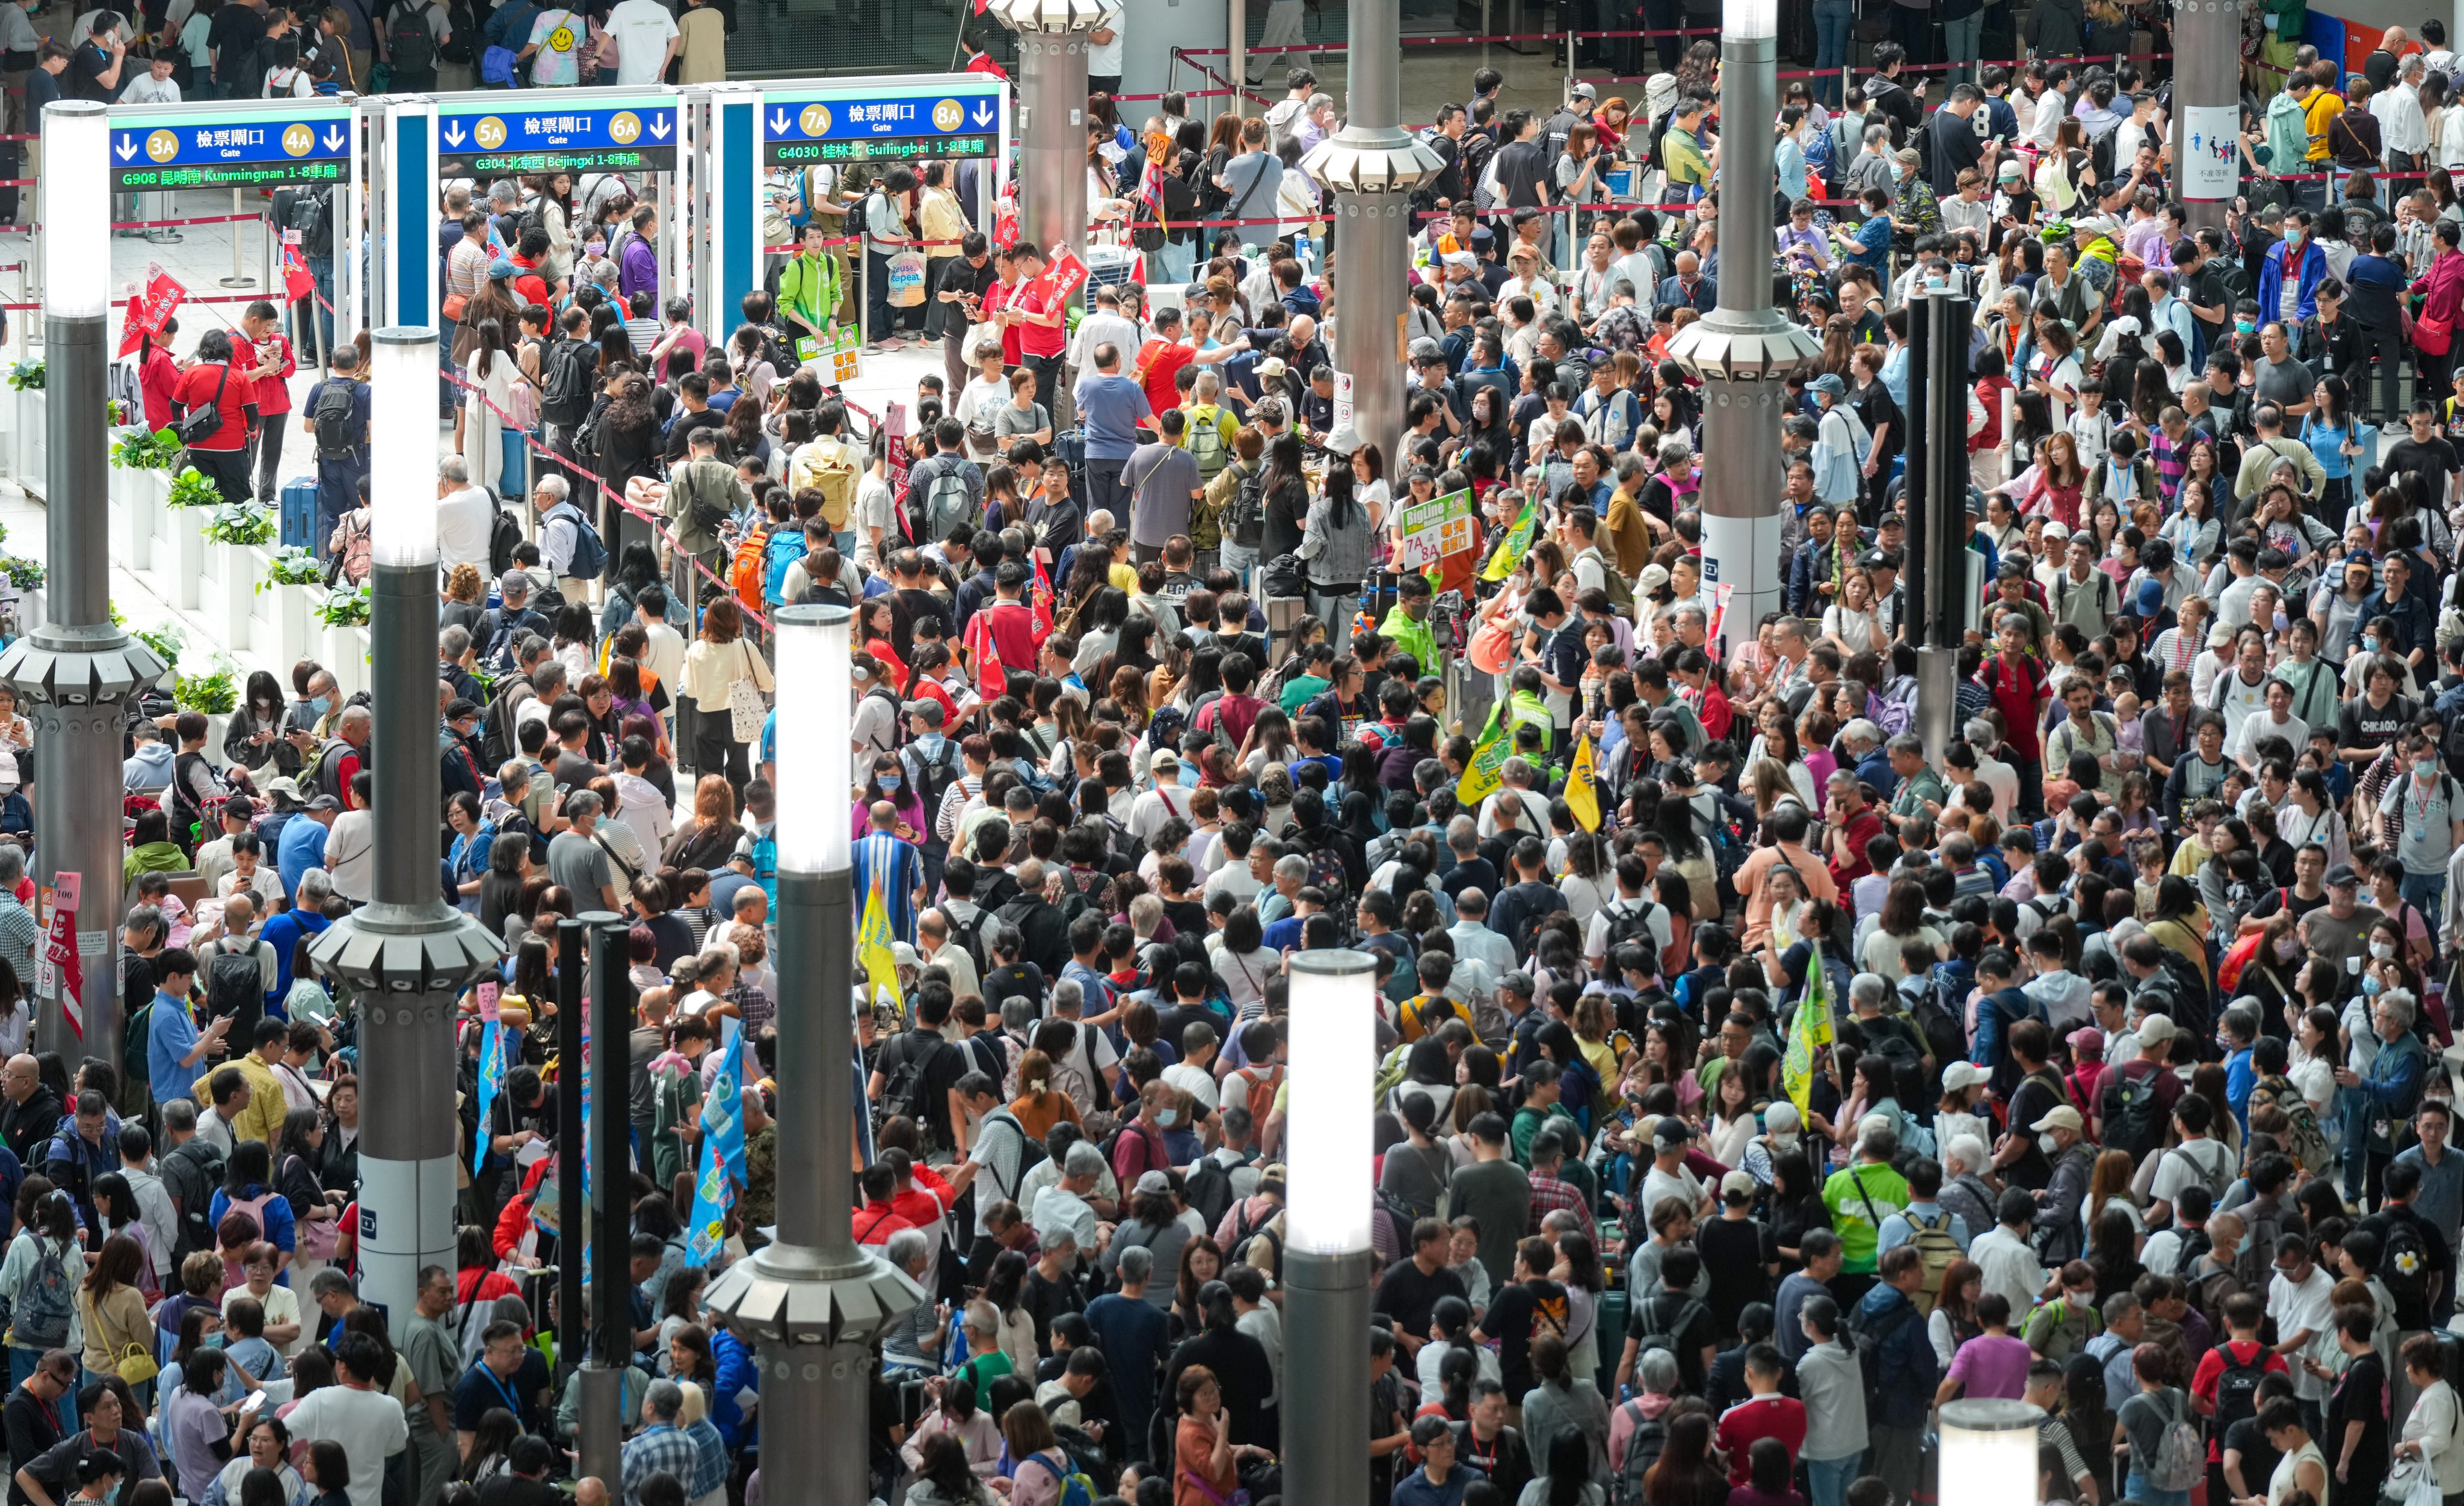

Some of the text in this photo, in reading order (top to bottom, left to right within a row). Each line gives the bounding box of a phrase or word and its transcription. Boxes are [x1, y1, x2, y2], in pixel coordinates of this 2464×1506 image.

[806, 112, 827, 129] 7A
[849, 105, 914, 123] 檢票閘口
[937, 107, 959, 124] 8A
[1973, 103, 1991, 137] 8
[481, 124, 502, 141] 5A
[525, 116, 591, 134] 檢票閘口
[614, 119, 636, 137] 6A
[872, 123, 892, 132] Gate
[152, 138, 175, 155] 3A
[197, 129, 265, 148] 檢票閘口
[287, 132, 311, 149] 4A
[548, 136, 568, 144] Gate
[221, 149, 241, 158] Gate
[777, 139, 984, 159] G4030 桂林北 Guilingbei 1-8車廂
[1148, 137, 1165, 160] 28
[476, 152, 640, 170] G304 北京西 Beijingxi 1-8車廂
[123, 164, 338, 185] G908 昆明南 Kunmingnan 1-8車廂
[2199, 169, 2229, 177] 不准等候
[891, 273, 922, 284] Repeat.
[817, 346, 836, 358] Holiday
[833, 350, 857, 368] 專列
[835, 364, 859, 383] 檢票口
[888, 408, 903, 431] 99
[1407, 501, 1445, 526] BigLine
[1423, 515, 1445, 530] Holiday
[1441, 518, 1466, 539] 專列
[1406, 536, 1423, 553] 7A
[1422, 544, 1439, 561] 8A
[1441, 533, 1467, 556] 檢票口
[2361, 720, 2397, 733] CHICAGO
[1473, 737, 1513, 776] 大航
[2404, 799, 2446, 814] YANKEES
[58, 890, 72, 899] 100
[483, 994, 496, 1009] 56
